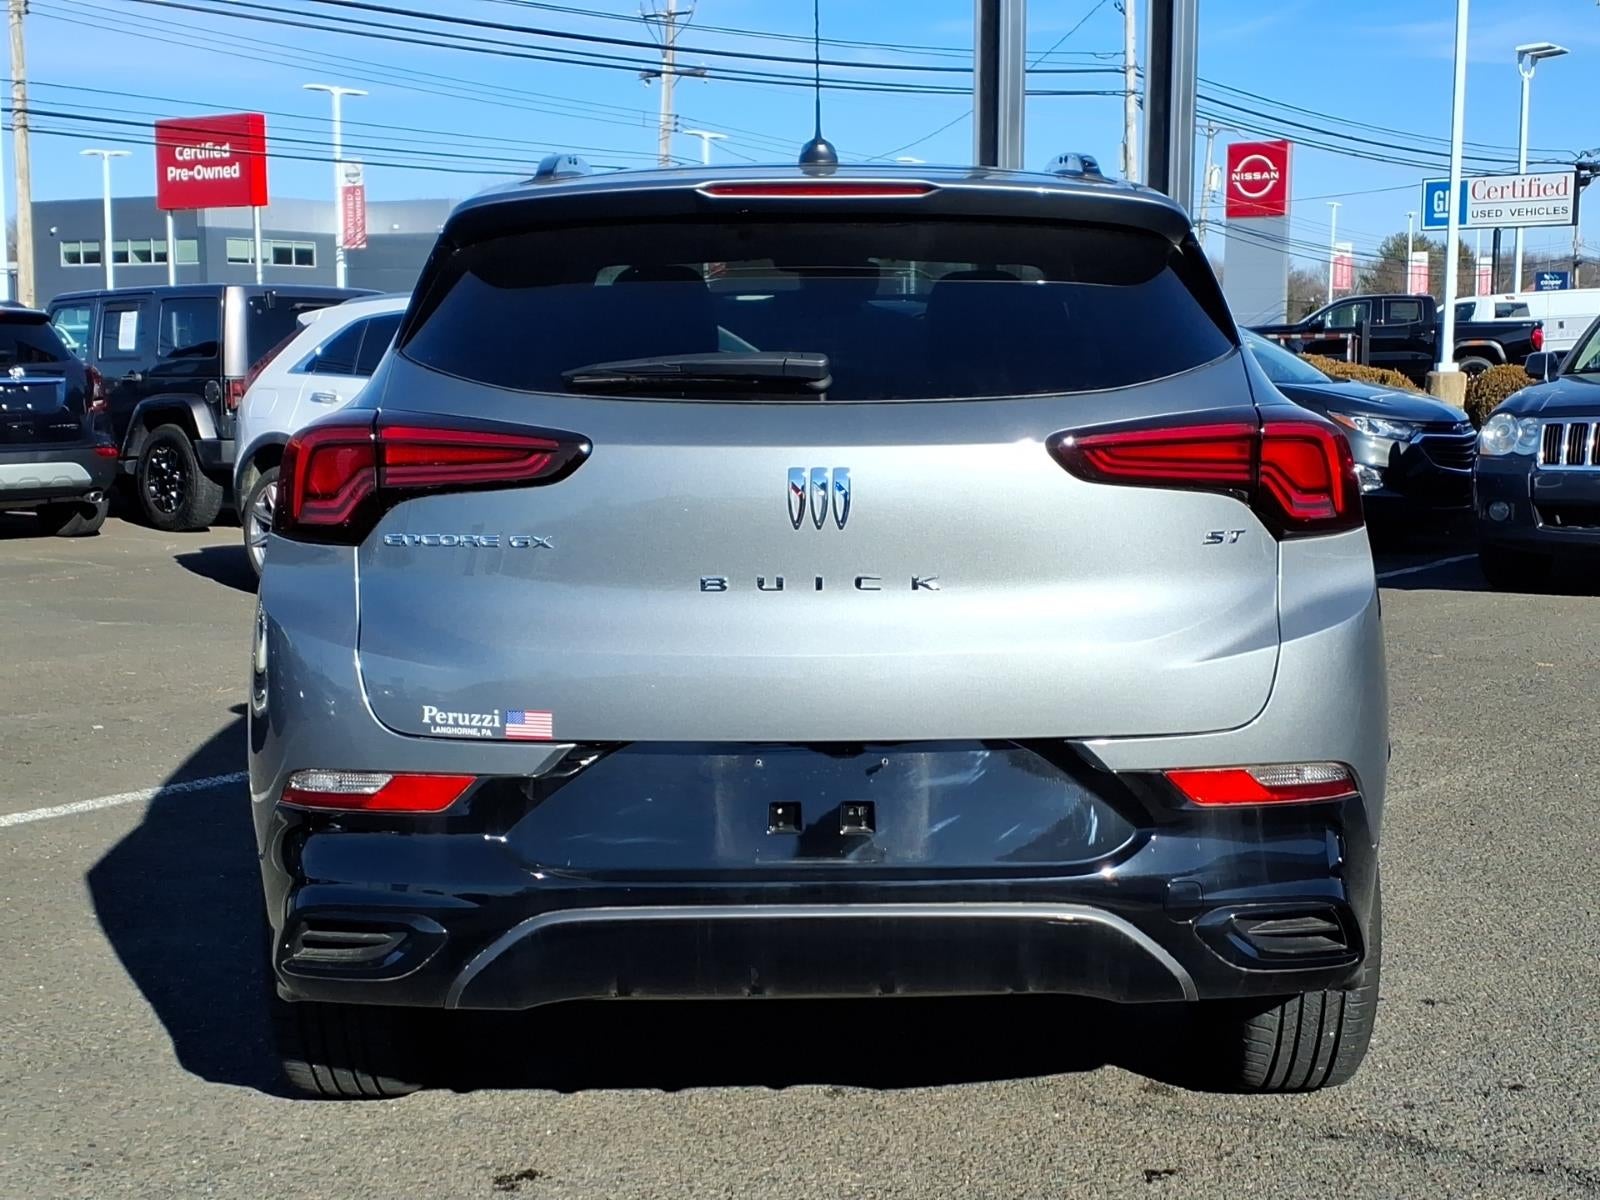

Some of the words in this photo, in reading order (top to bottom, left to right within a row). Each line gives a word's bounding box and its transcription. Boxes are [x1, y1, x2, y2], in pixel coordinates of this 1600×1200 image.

[174, 141, 230, 161] Certified
[166, 161, 240, 181] Pre-Owned
[1232, 171, 1280, 181] NISSAN
[1471, 175, 1569, 201] Certified
[1471, 208, 1503, 219] USED
[1509, 206, 1569, 218] VEHICLES
[384, 533, 500, 548] ENCORE
[508, 535, 553, 549] GX
[1202, 529, 1247, 545] ST
[700, 576, 941, 592] BUICK
[421, 705, 501, 728] Peruzzi
[481, 729, 493, 737] PA
